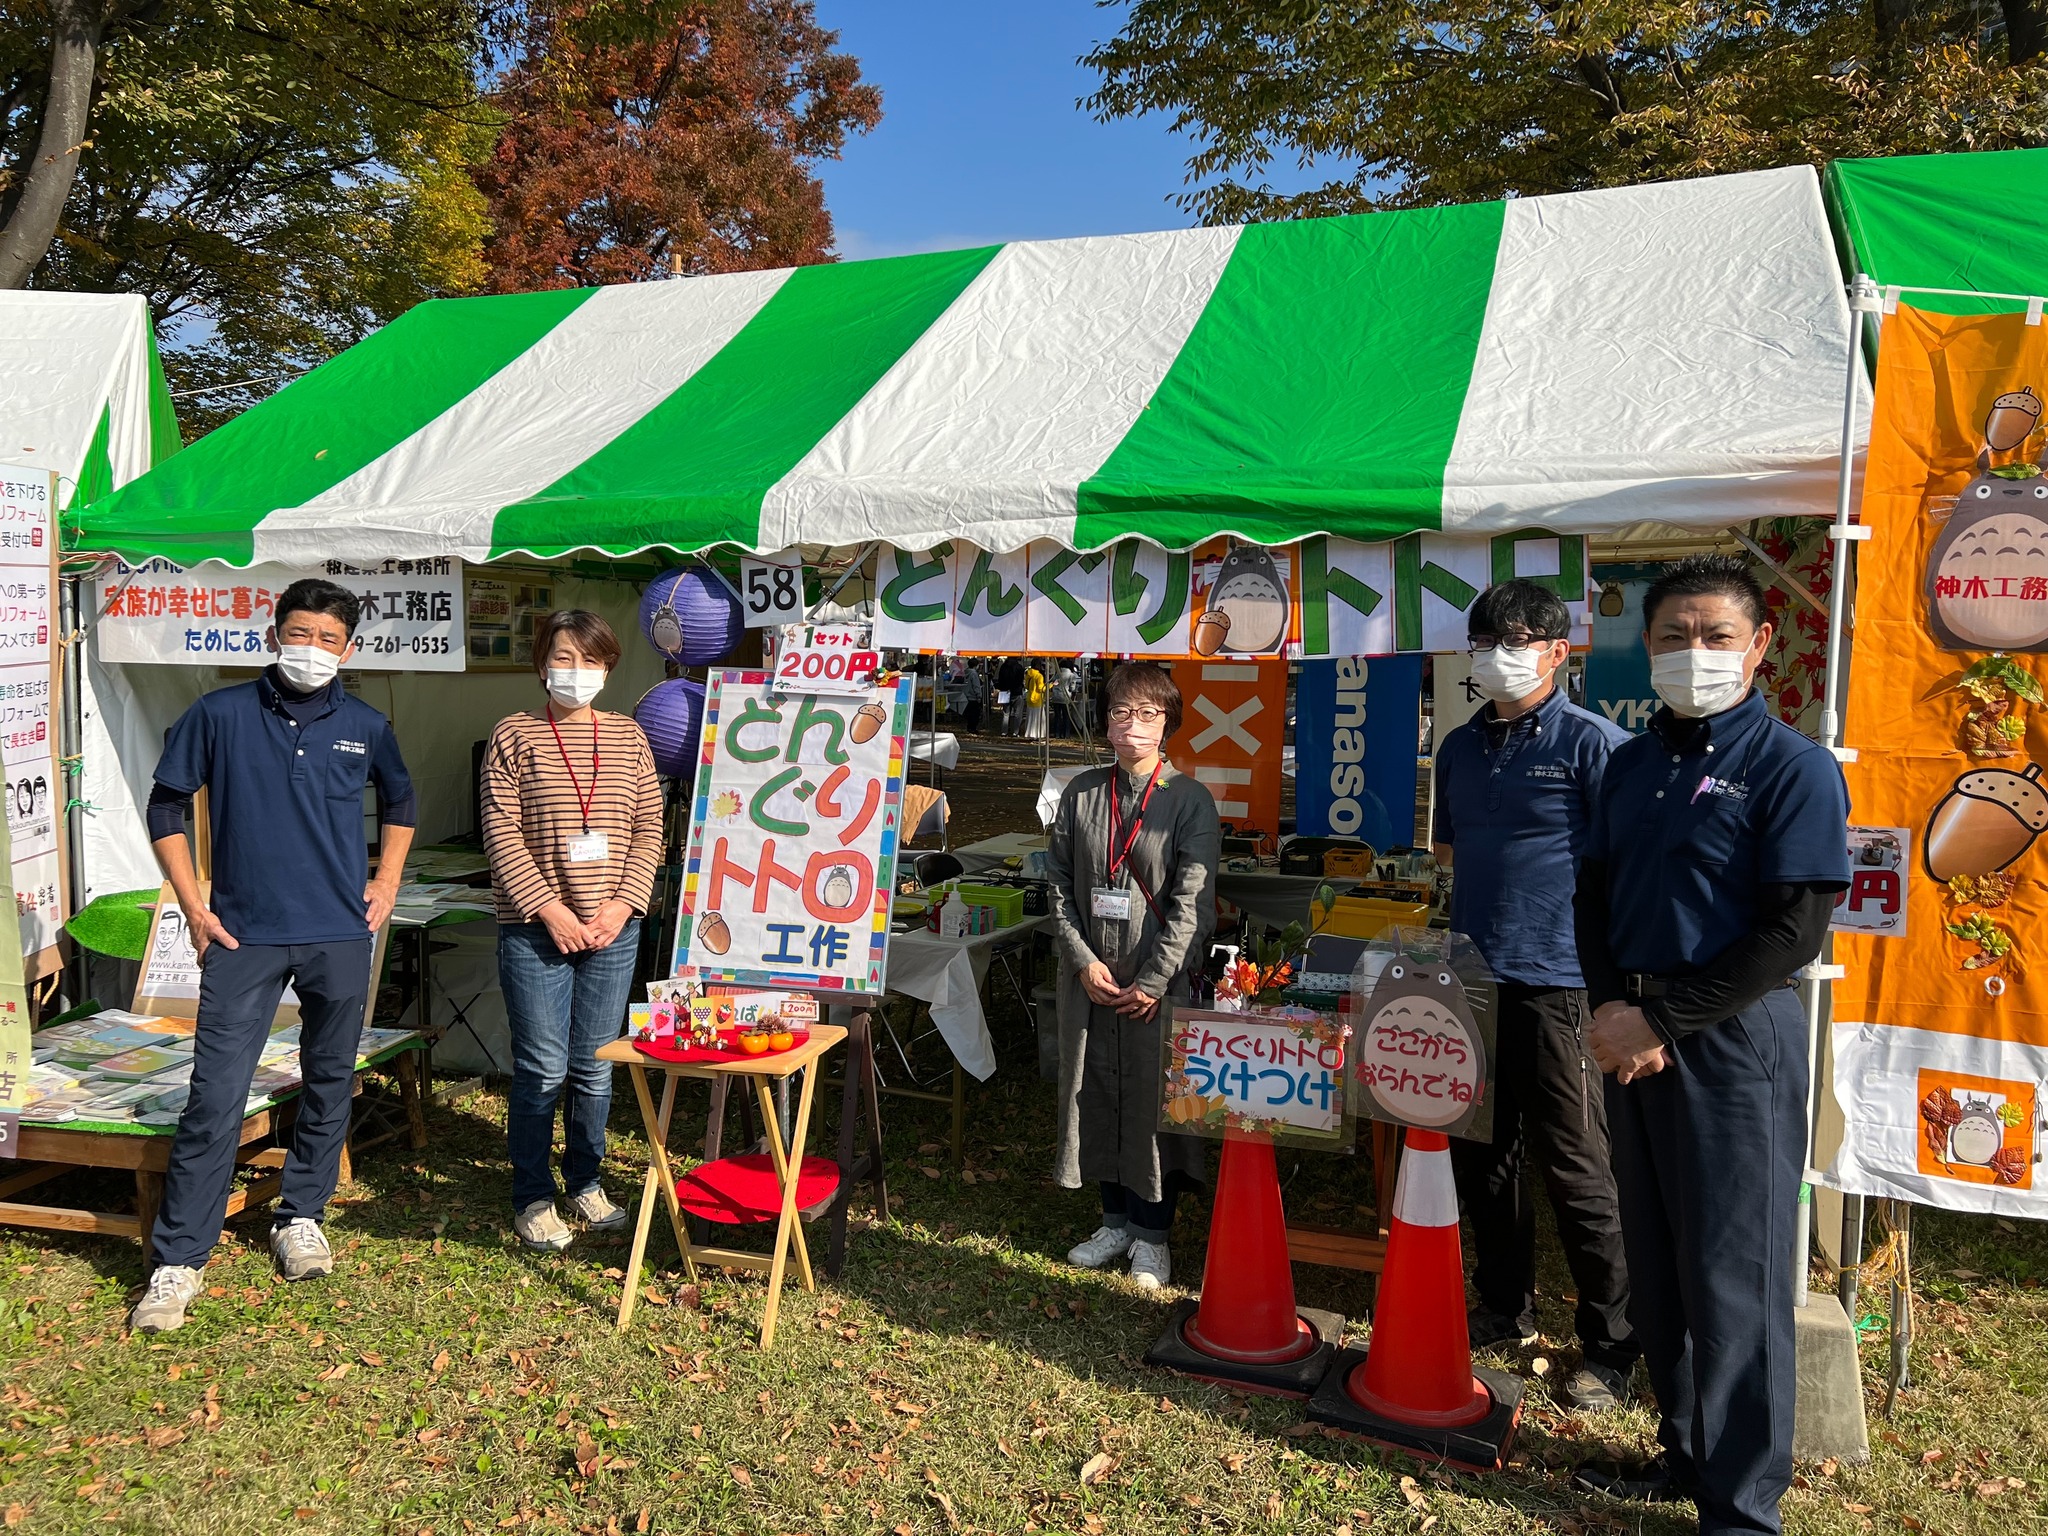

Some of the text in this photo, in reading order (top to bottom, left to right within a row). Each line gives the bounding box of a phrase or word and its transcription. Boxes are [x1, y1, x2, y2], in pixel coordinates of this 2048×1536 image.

[320, 555, 451, 577] 級建士事務所
[1934, 574, 2048, 602] 神木工務
[104, 585, 283, 620] 家族が幸せに暮ら
[748, 567, 797, 614] 58
[880, 527, 1585, 655] どんぐり トトロ
[185, 628, 272, 653] ためにあ
[779, 650, 878, 682] 200円
[724, 693, 851, 765] どん
[1328, 656, 1369, 841] anaso
[750, 765, 881, 847] ぐり
[706, 836, 874, 923] トトロ
[1834, 869, 1901, 915] 円
[761, 923, 850, 968] 工作
[1174, 1026, 1345, 1070] どんぐりトトロ
[1377, 1028, 1467, 1065] ここから
[1184, 1055, 1337, 1111] うけつけ
